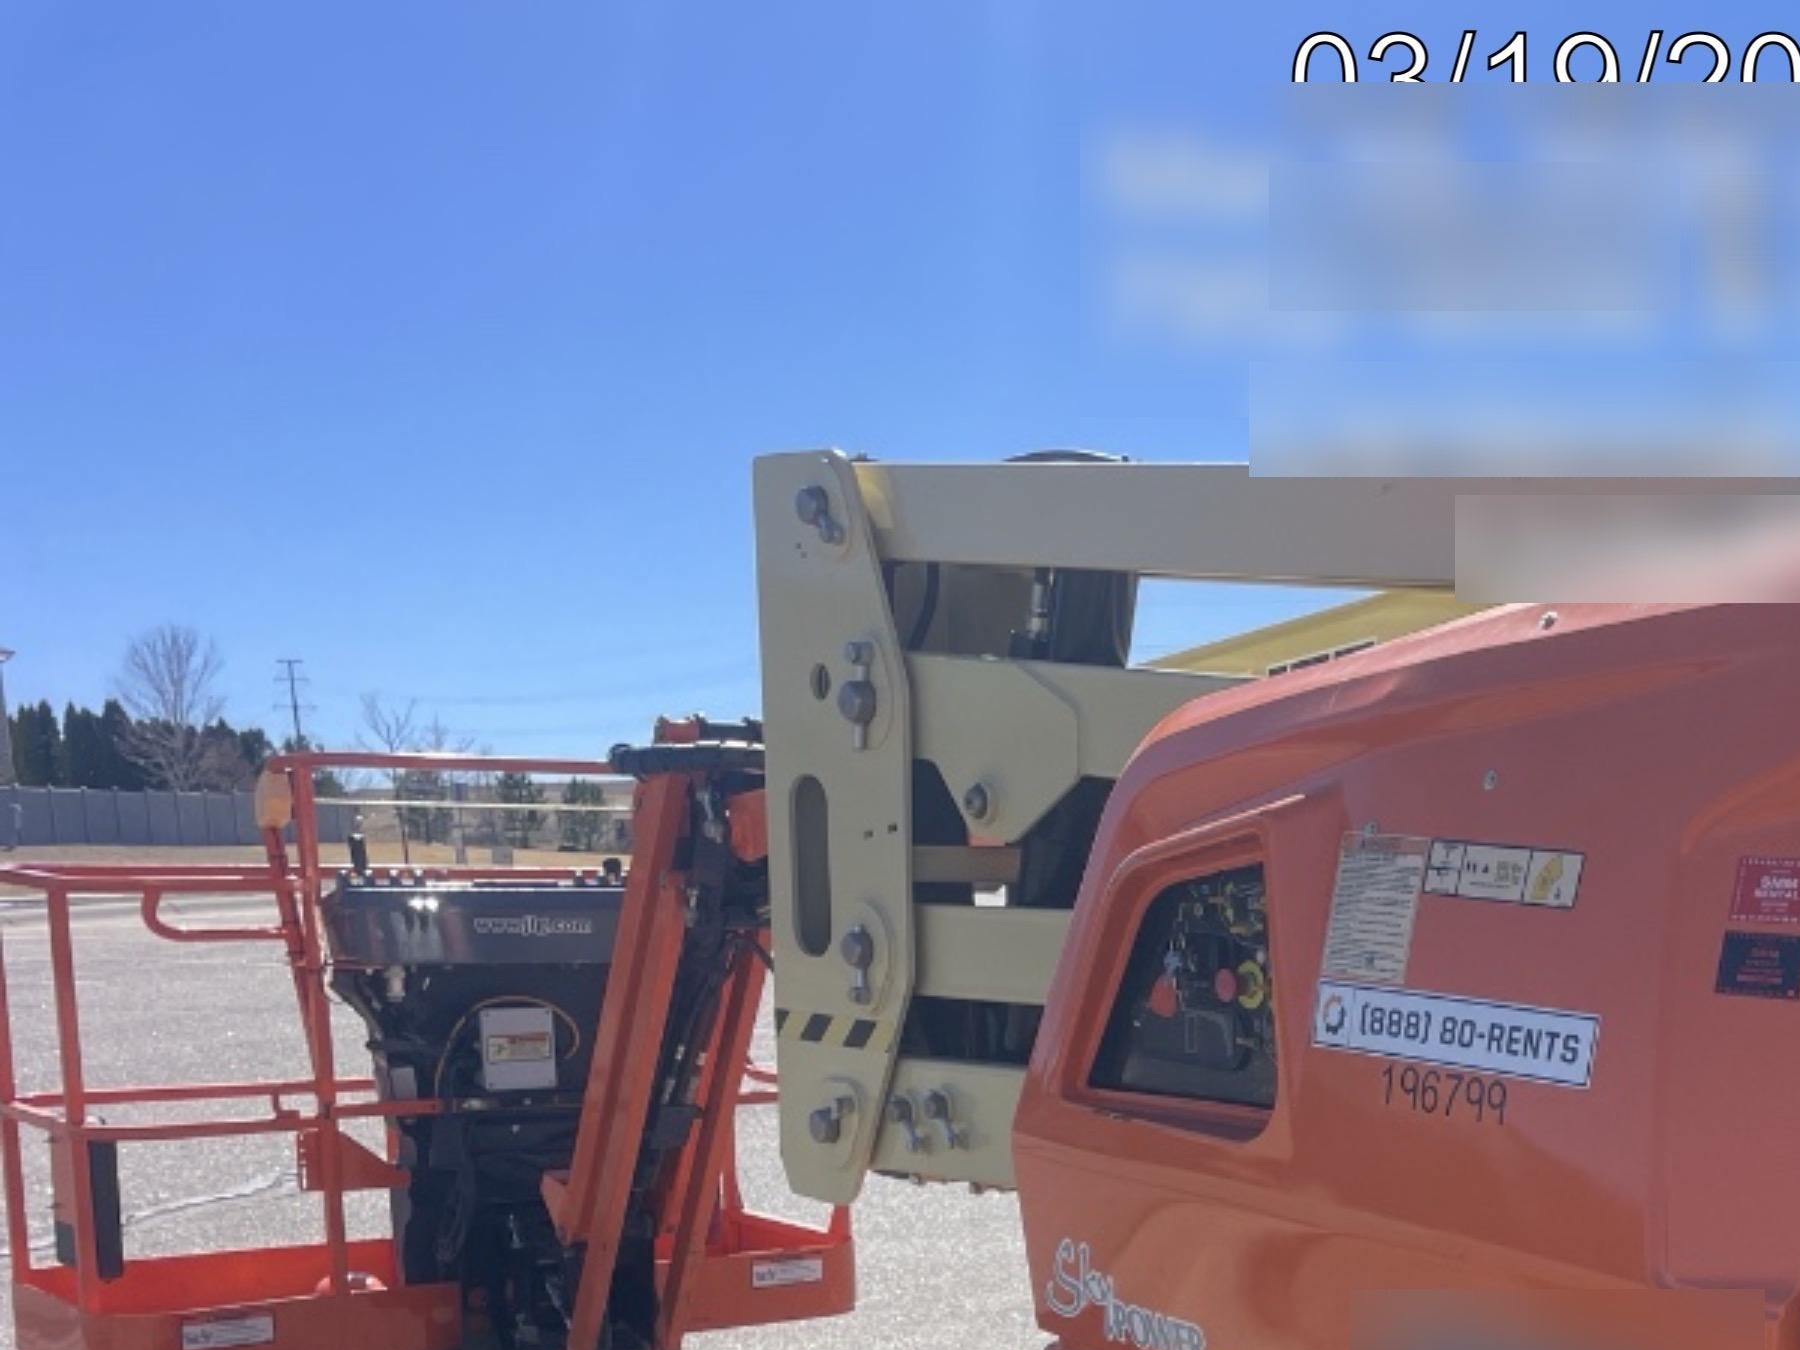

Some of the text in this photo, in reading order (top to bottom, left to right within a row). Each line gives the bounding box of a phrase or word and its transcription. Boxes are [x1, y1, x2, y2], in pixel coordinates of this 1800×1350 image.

[473, 915, 593, 937] www.jlg.com
[1360, 1002, 1581, 1064] (888) 80-RENTS
[1382, 1063, 1508, 1126] 196799
